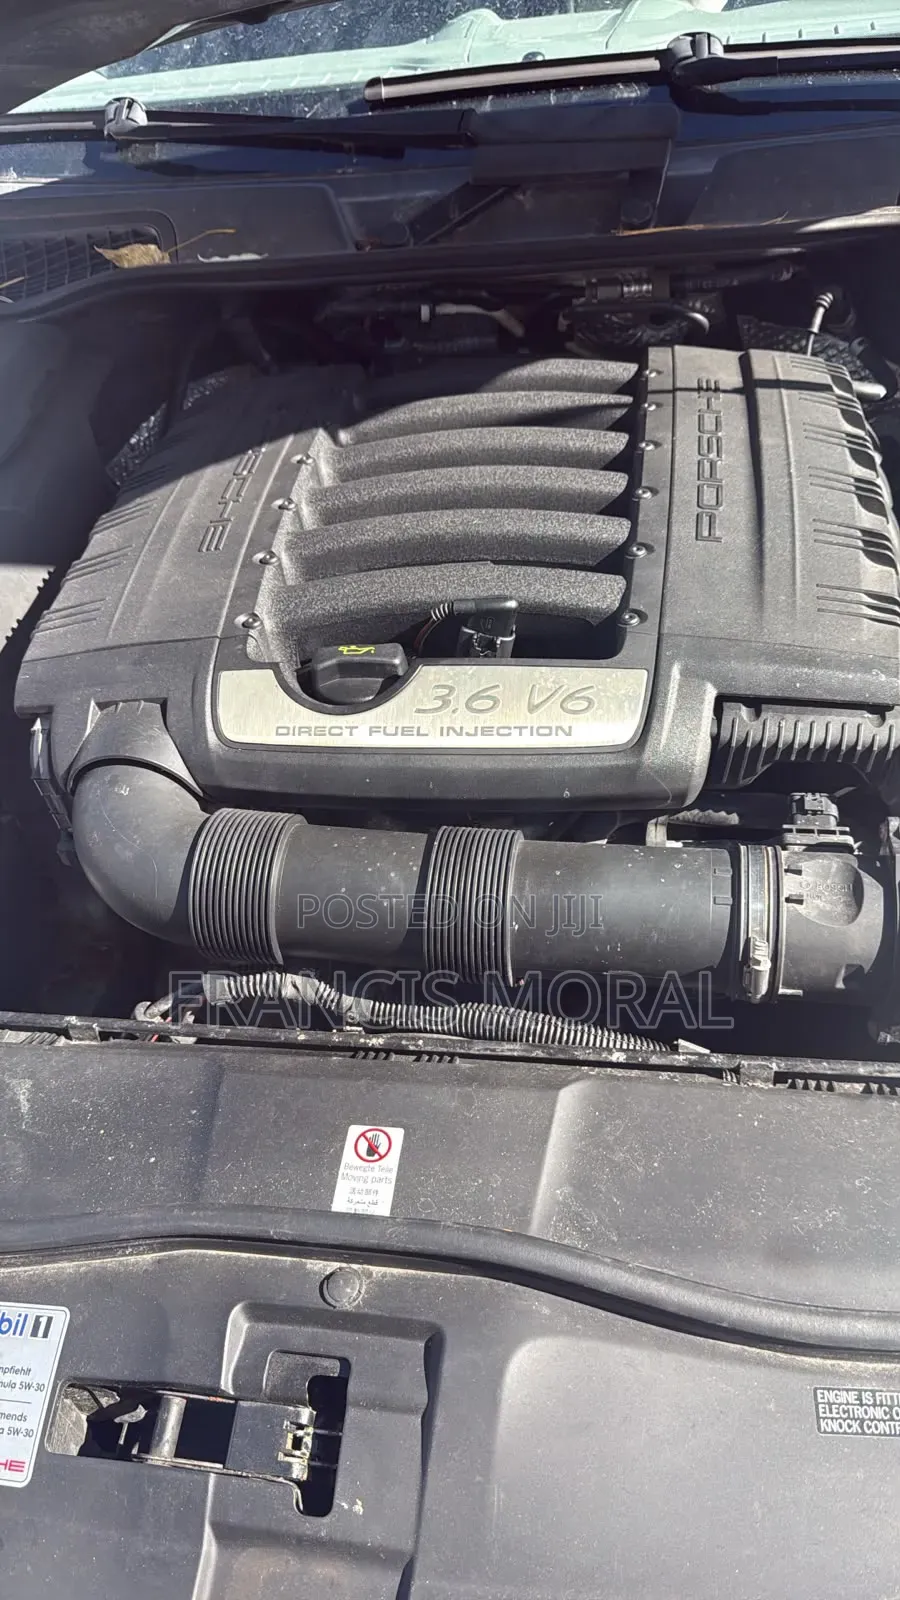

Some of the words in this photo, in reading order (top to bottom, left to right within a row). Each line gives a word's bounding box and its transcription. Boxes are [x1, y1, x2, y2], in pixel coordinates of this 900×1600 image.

[696, 377, 723, 543] PORSCHE
[414, 683, 502, 715] 3.6
[527, 683, 596, 715] V6
[275, 725, 358, 737] DIRECT
[369, 725, 429, 737] FUEL
[440, 725, 573, 737] INJECTION
[341, 1172, 369, 1184] Moving
[370, 1175, 393, 1184] parts
[18, 1380, 46, 1392] 5W-30
[816, 1389, 860, 1404] ENGINE
[862, 1391, 874, 1405] IS
[875, 1391, 900, 1406] FITT
[818, 1404, 890, 1420] ELECTRONIC
[7, 1426, 35, 1438] 5W-30
[819, 1418, 862, 1433] KNOCK
